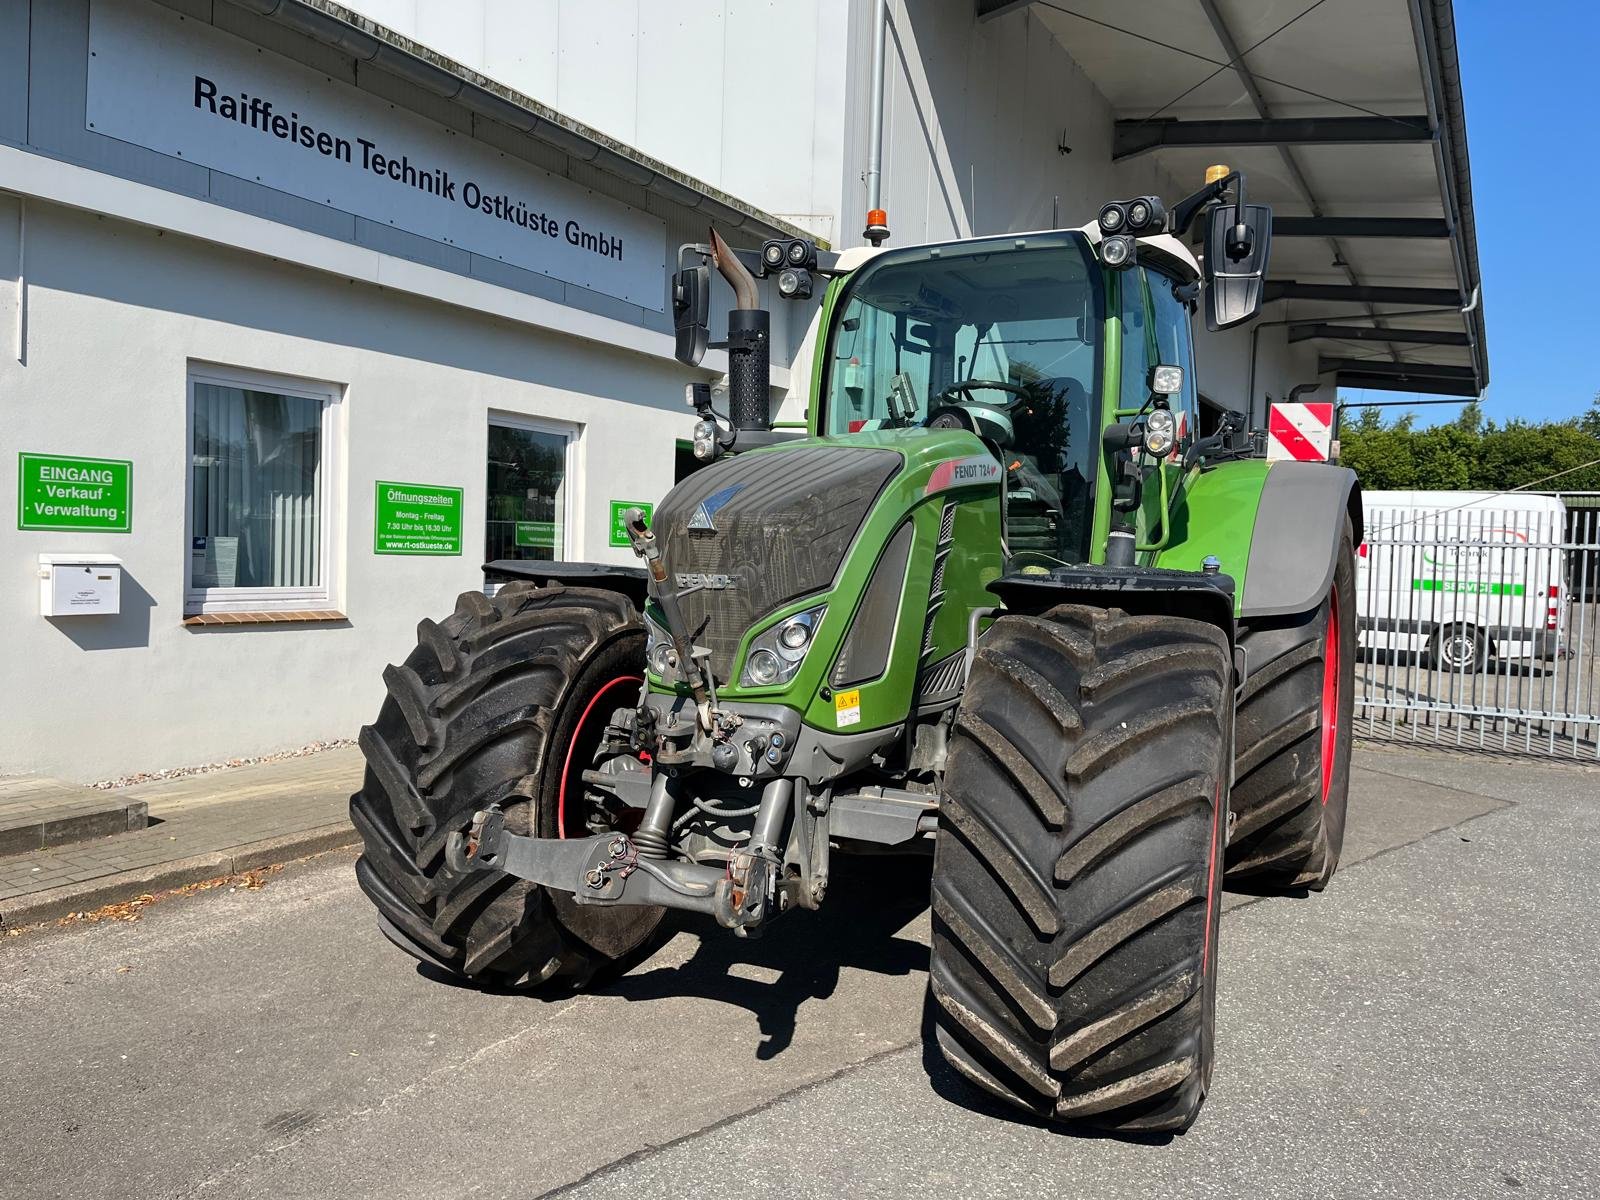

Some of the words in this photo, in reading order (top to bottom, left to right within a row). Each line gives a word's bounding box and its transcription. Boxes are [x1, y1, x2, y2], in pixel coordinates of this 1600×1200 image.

[193, 75, 352, 163] Raiffeisen
[356, 138, 456, 201] Technik
[462, 182, 559, 238] Ostküste
[565, 220, 624, 261] GmbH
[39, 466, 113, 483] EINGANG
[954, 465, 977, 479] FENDT
[46, 485, 103, 500] Verkauf
[387, 488, 453, 505] Öffnungszeiten
[34, 502, 118, 521] Verwaltung
[396, 512, 419, 521] Montag
[424, 512, 445, 522] Freitag
[387, 522, 400, 530] 7.30
[401, 523, 413, 531] Uhr
[413, 523, 426, 531] bis
[441, 525, 452, 533] Uhr
[386, 541, 452, 550] www.rt-ostkueste.de
